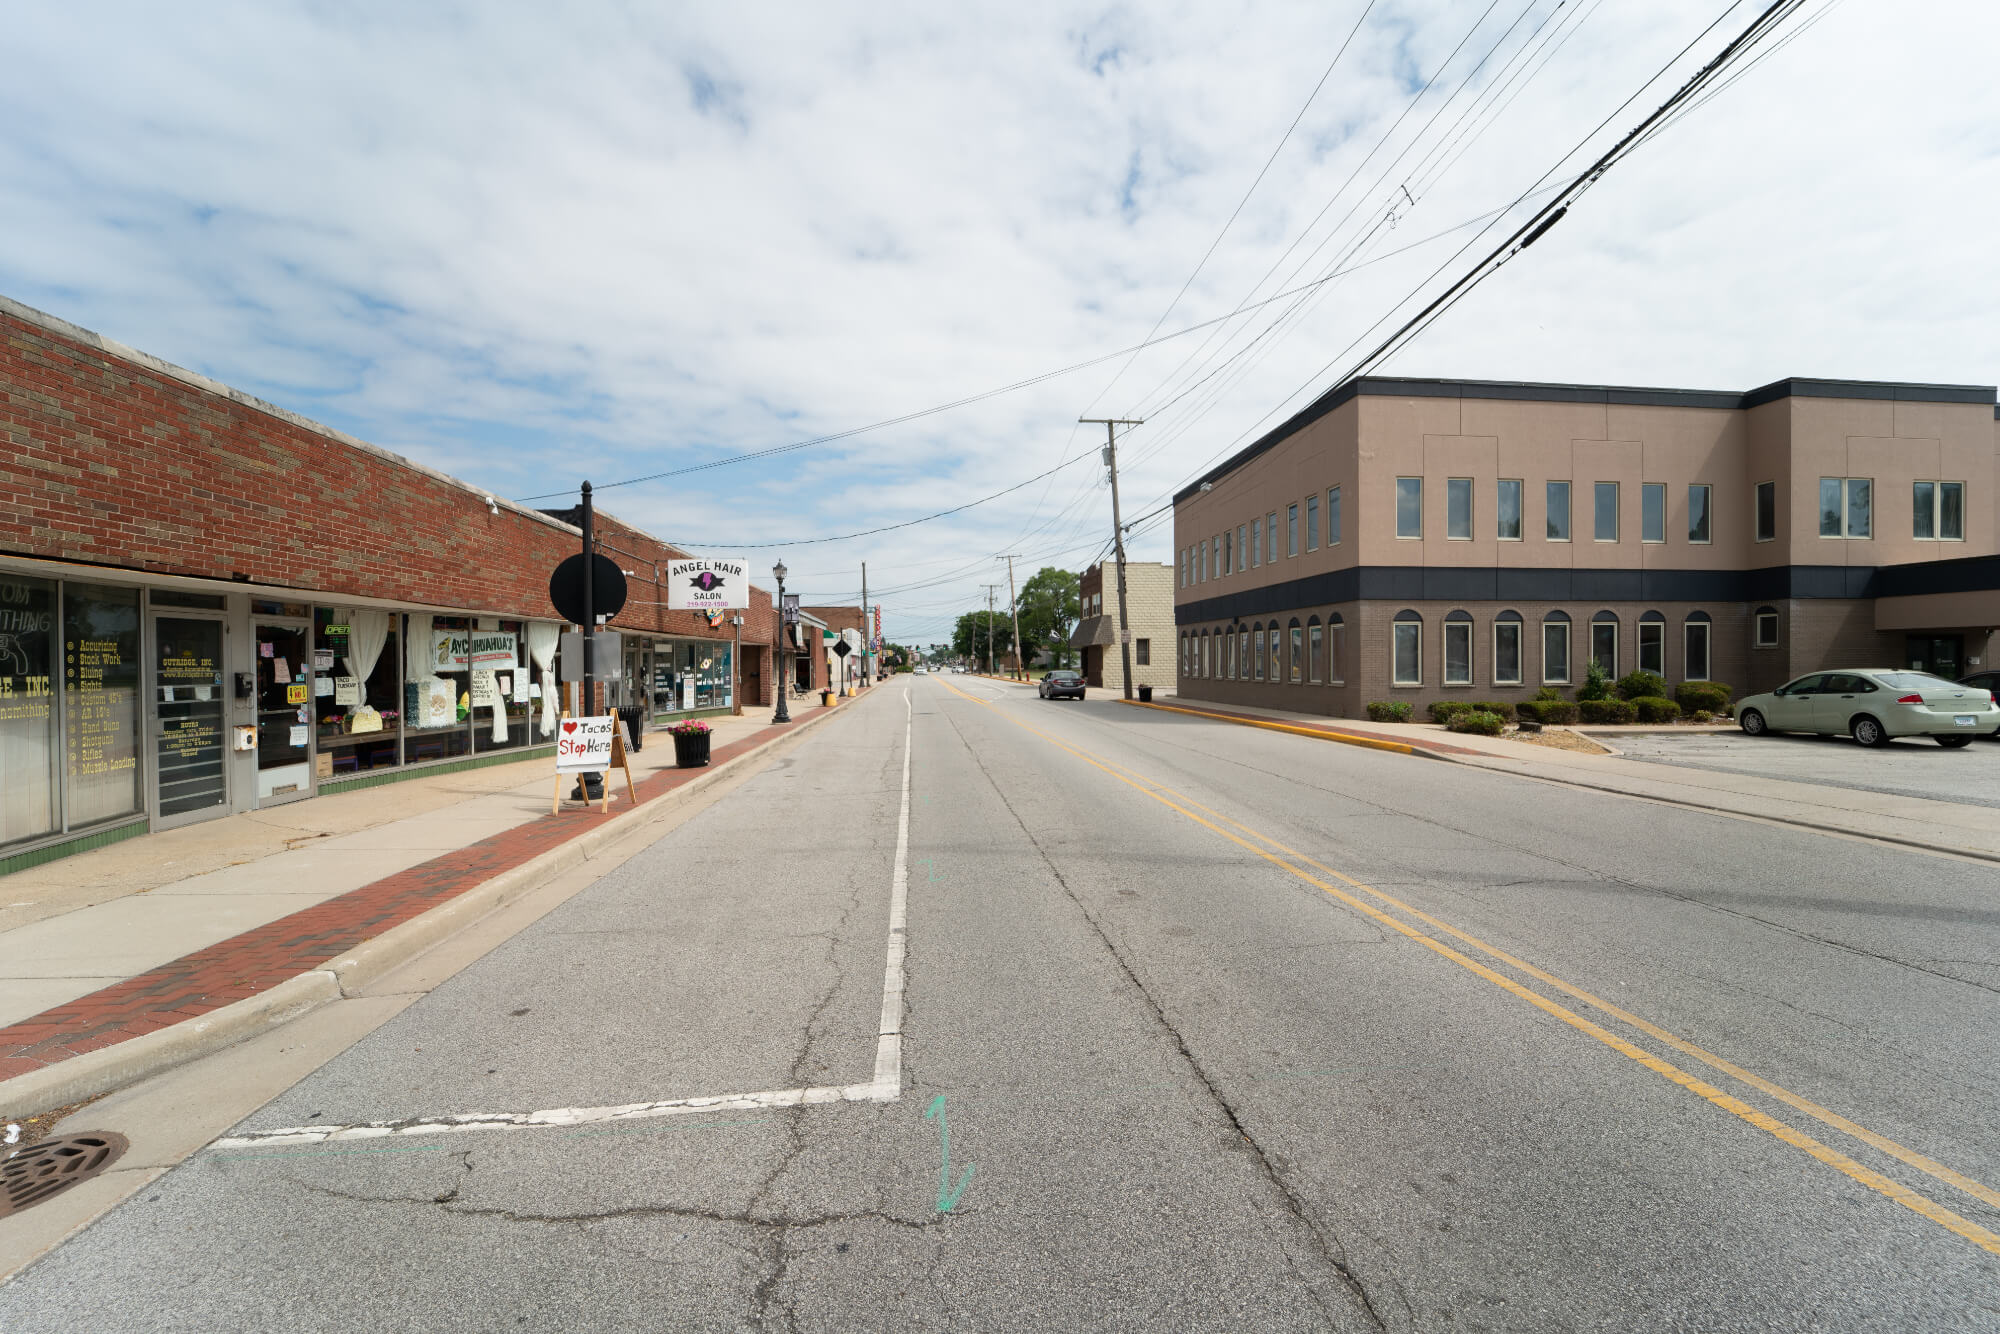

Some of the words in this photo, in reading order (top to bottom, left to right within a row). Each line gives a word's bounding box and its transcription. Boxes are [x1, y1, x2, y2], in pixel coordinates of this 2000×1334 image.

[673, 562, 710, 576] ANGEL
[714, 562, 741, 576] HAIR
[694, 592, 722, 600] SALON
[80, 653, 100, 665] Stock
[102, 653, 121, 665] Work
[80, 667, 103, 680] Bluing
[26, 676, 54, 697] INC.
[81, 680, 103, 694] Sights
[581, 723, 612, 734] Tacos
[82, 735, 114, 748] Shotguns
[82, 748, 103, 761] Rifles
[560, 739, 587, 758] Stop
[587, 739, 611, 753] Here
[82, 760, 108, 775] Muzzle
[110, 756, 136, 772] Loading
